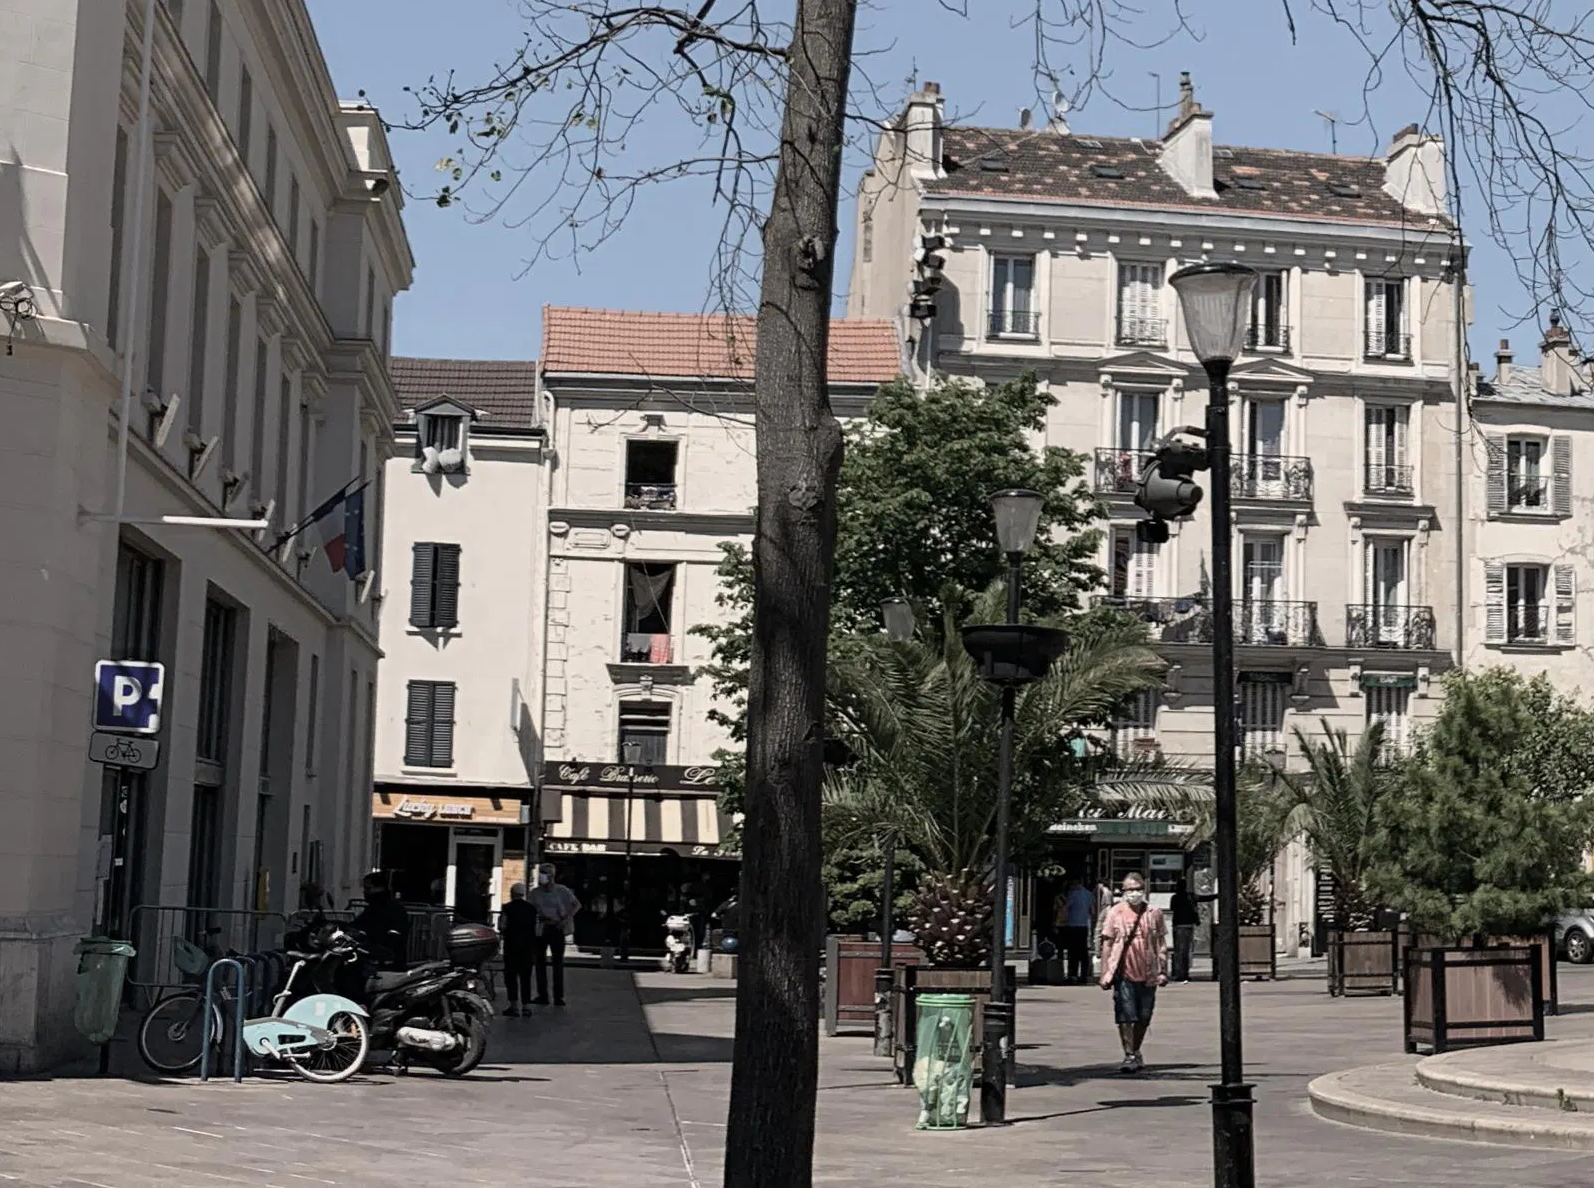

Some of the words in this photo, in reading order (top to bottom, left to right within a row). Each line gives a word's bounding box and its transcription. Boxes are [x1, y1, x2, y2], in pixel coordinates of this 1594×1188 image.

[113, 675, 142, 717] P
[558, 763, 591, 785] Café
[599, 765, 660, 784] Braserie
